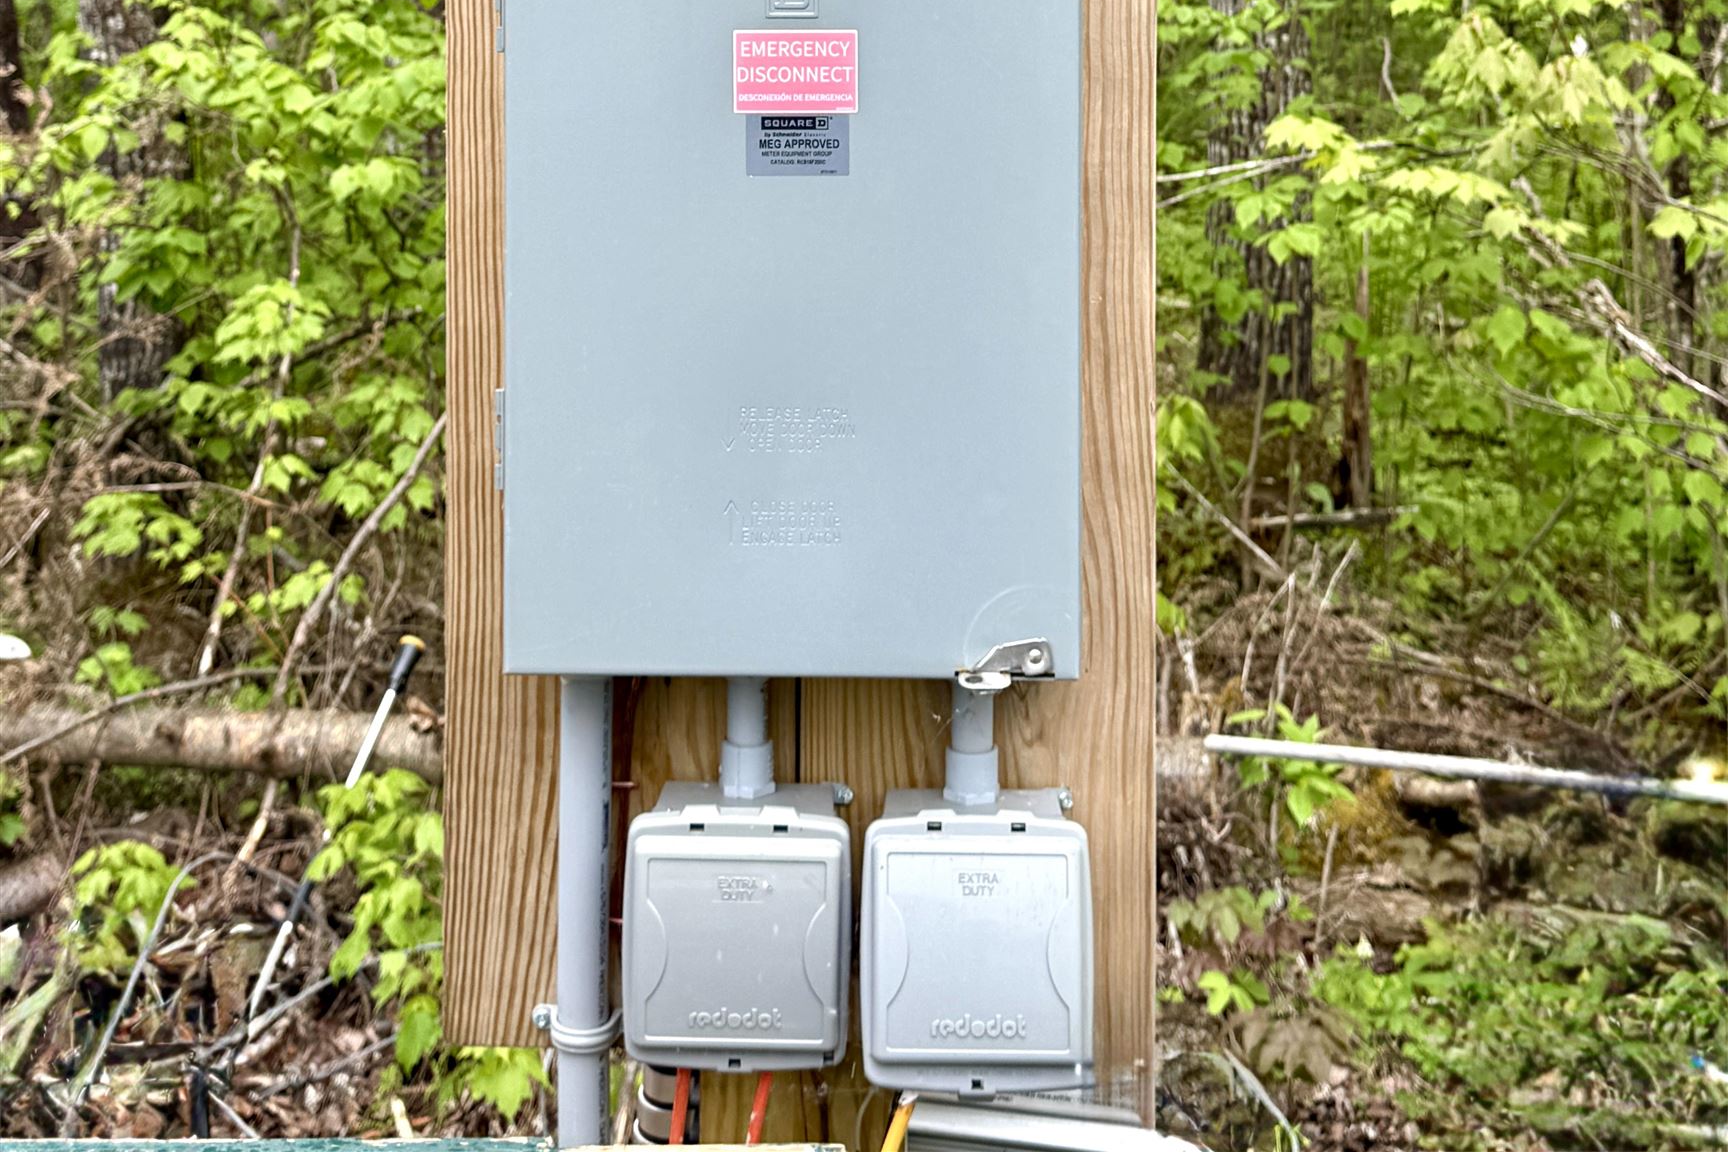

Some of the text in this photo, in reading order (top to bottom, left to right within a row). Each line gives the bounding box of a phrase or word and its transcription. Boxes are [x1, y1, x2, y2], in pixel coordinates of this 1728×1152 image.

[740, 40, 851, 58] EMERGENCY
[736, 65, 854, 84] DISCONNECT
[793, 93, 804, 102] DE
[805, 93, 853, 102] EMERGENCIA
[764, 118, 827, 128] SQUARE D
[759, 138, 840, 149] MEG APPROVED
[740, 406, 801, 422] RELEASE
[742, 531, 841, 546] ENGAGE LATCH
[716, 876, 758, 889] EXTRA
[958, 871, 999, 884] EXTRA
[721, 889, 754, 901] DUTY
[962, 884, 995, 897] DUTY
